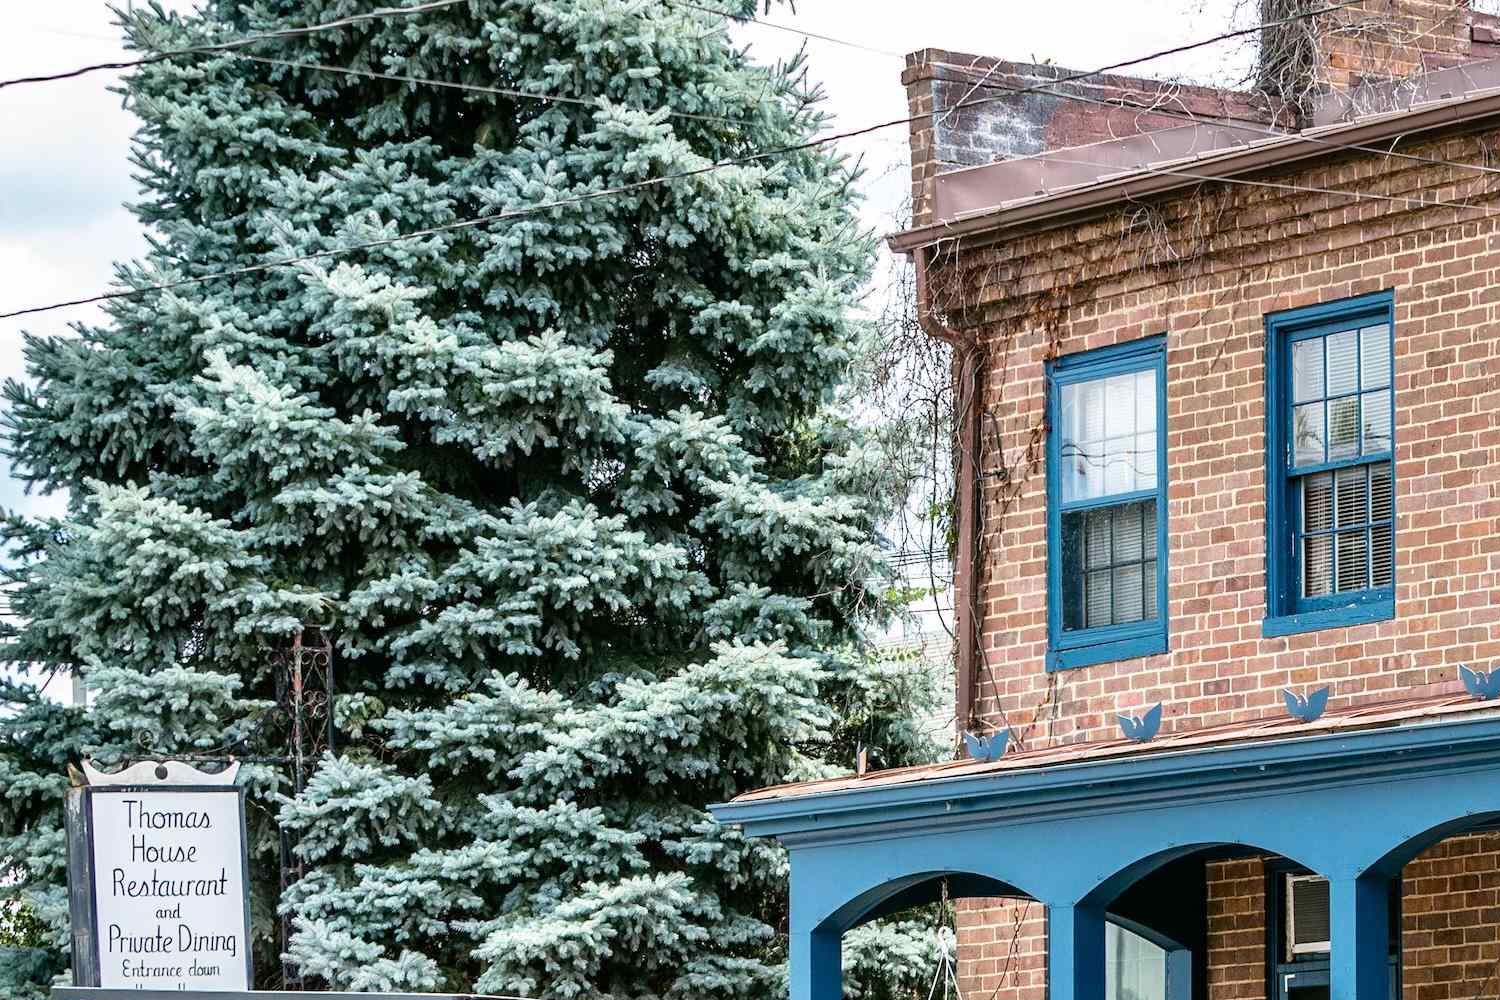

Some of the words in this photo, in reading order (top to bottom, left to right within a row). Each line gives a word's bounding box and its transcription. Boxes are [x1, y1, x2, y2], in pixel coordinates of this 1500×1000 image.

[122, 800, 212, 829] Thomas
[132, 834, 198, 863] House
[112, 867, 228, 898] Restaurant
[155, 903, 182, 919] and
[109, 924, 173, 954] Private
[178, 924, 236, 957] Dining
[122, 958, 183, 978] Entrance
[188, 958, 220, 977] down
